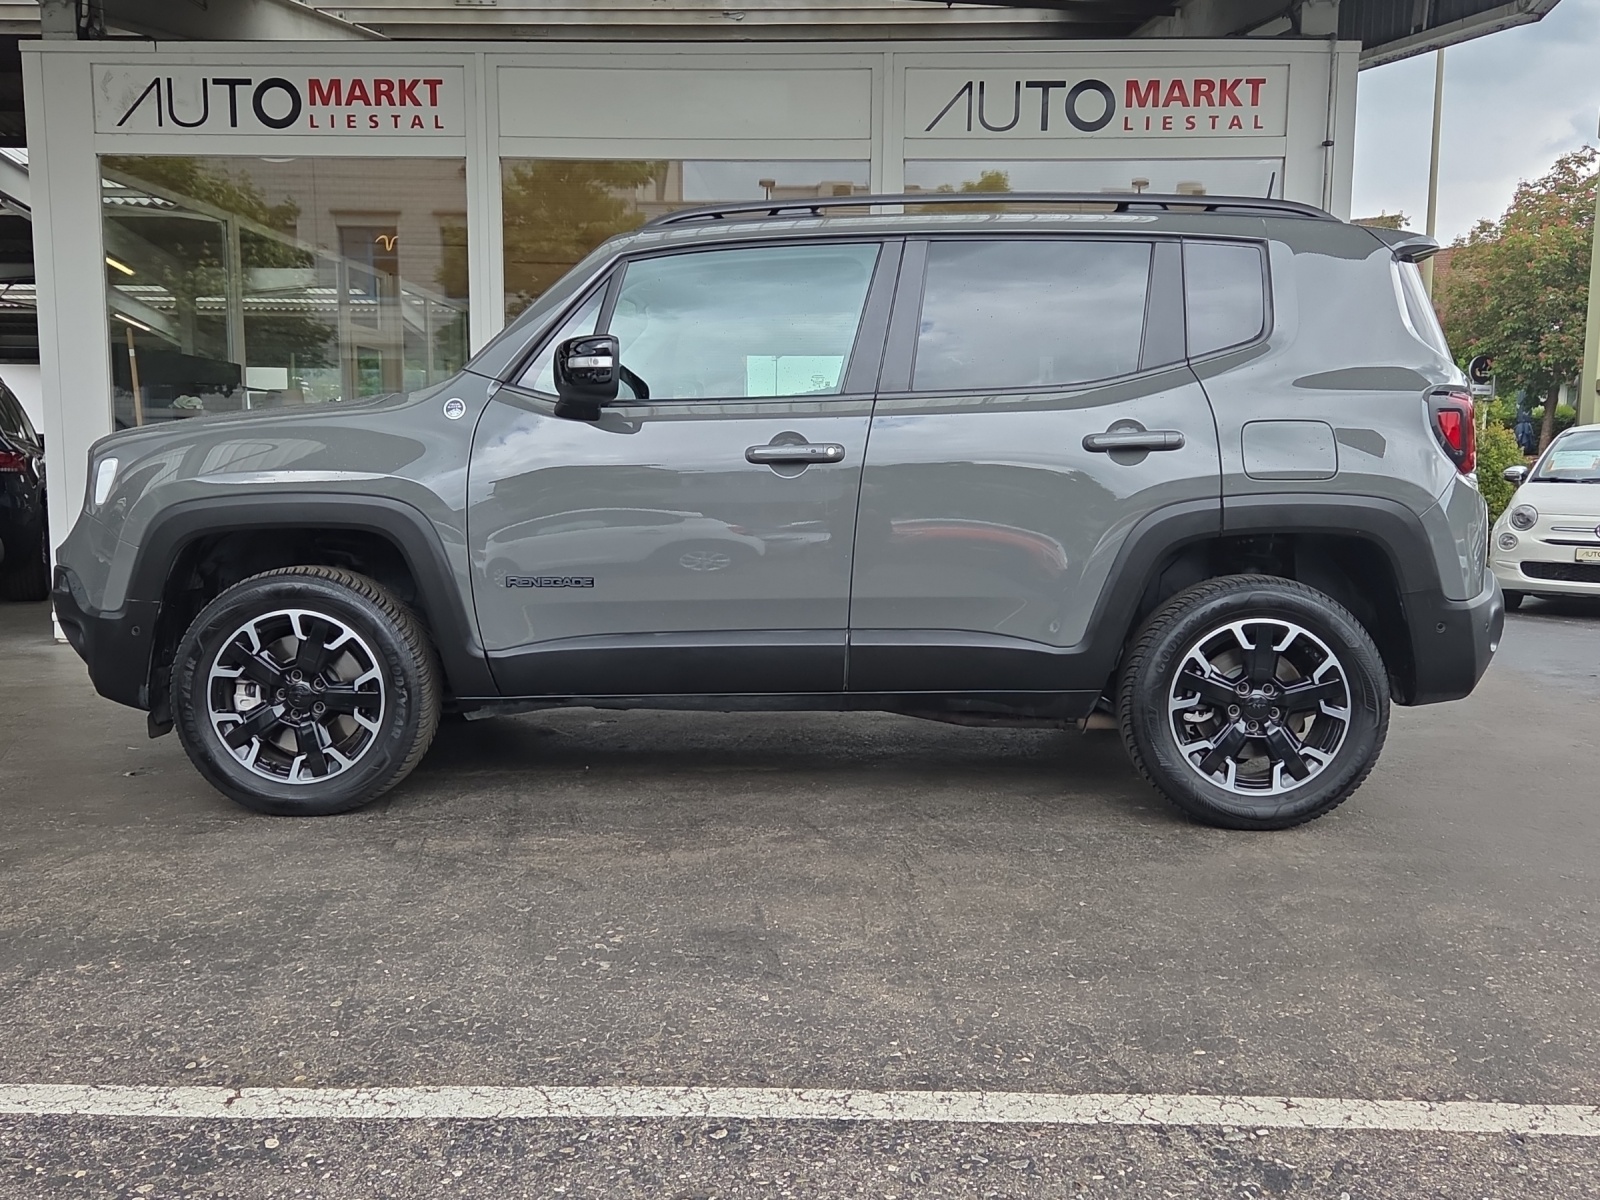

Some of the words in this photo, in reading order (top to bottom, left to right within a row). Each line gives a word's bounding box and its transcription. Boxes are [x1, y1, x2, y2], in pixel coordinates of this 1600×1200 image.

[116, 77, 302, 129] AUTO
[307, 78, 444, 107] MARKT
[924, 79, 1116, 132] AUTO
[1125, 78, 1267, 108] MARKT
[309, 114, 445, 129] LIESTAL
[1124, 115, 1264, 131] LIESTAL
[505, 576, 595, 588] RENEGADE
